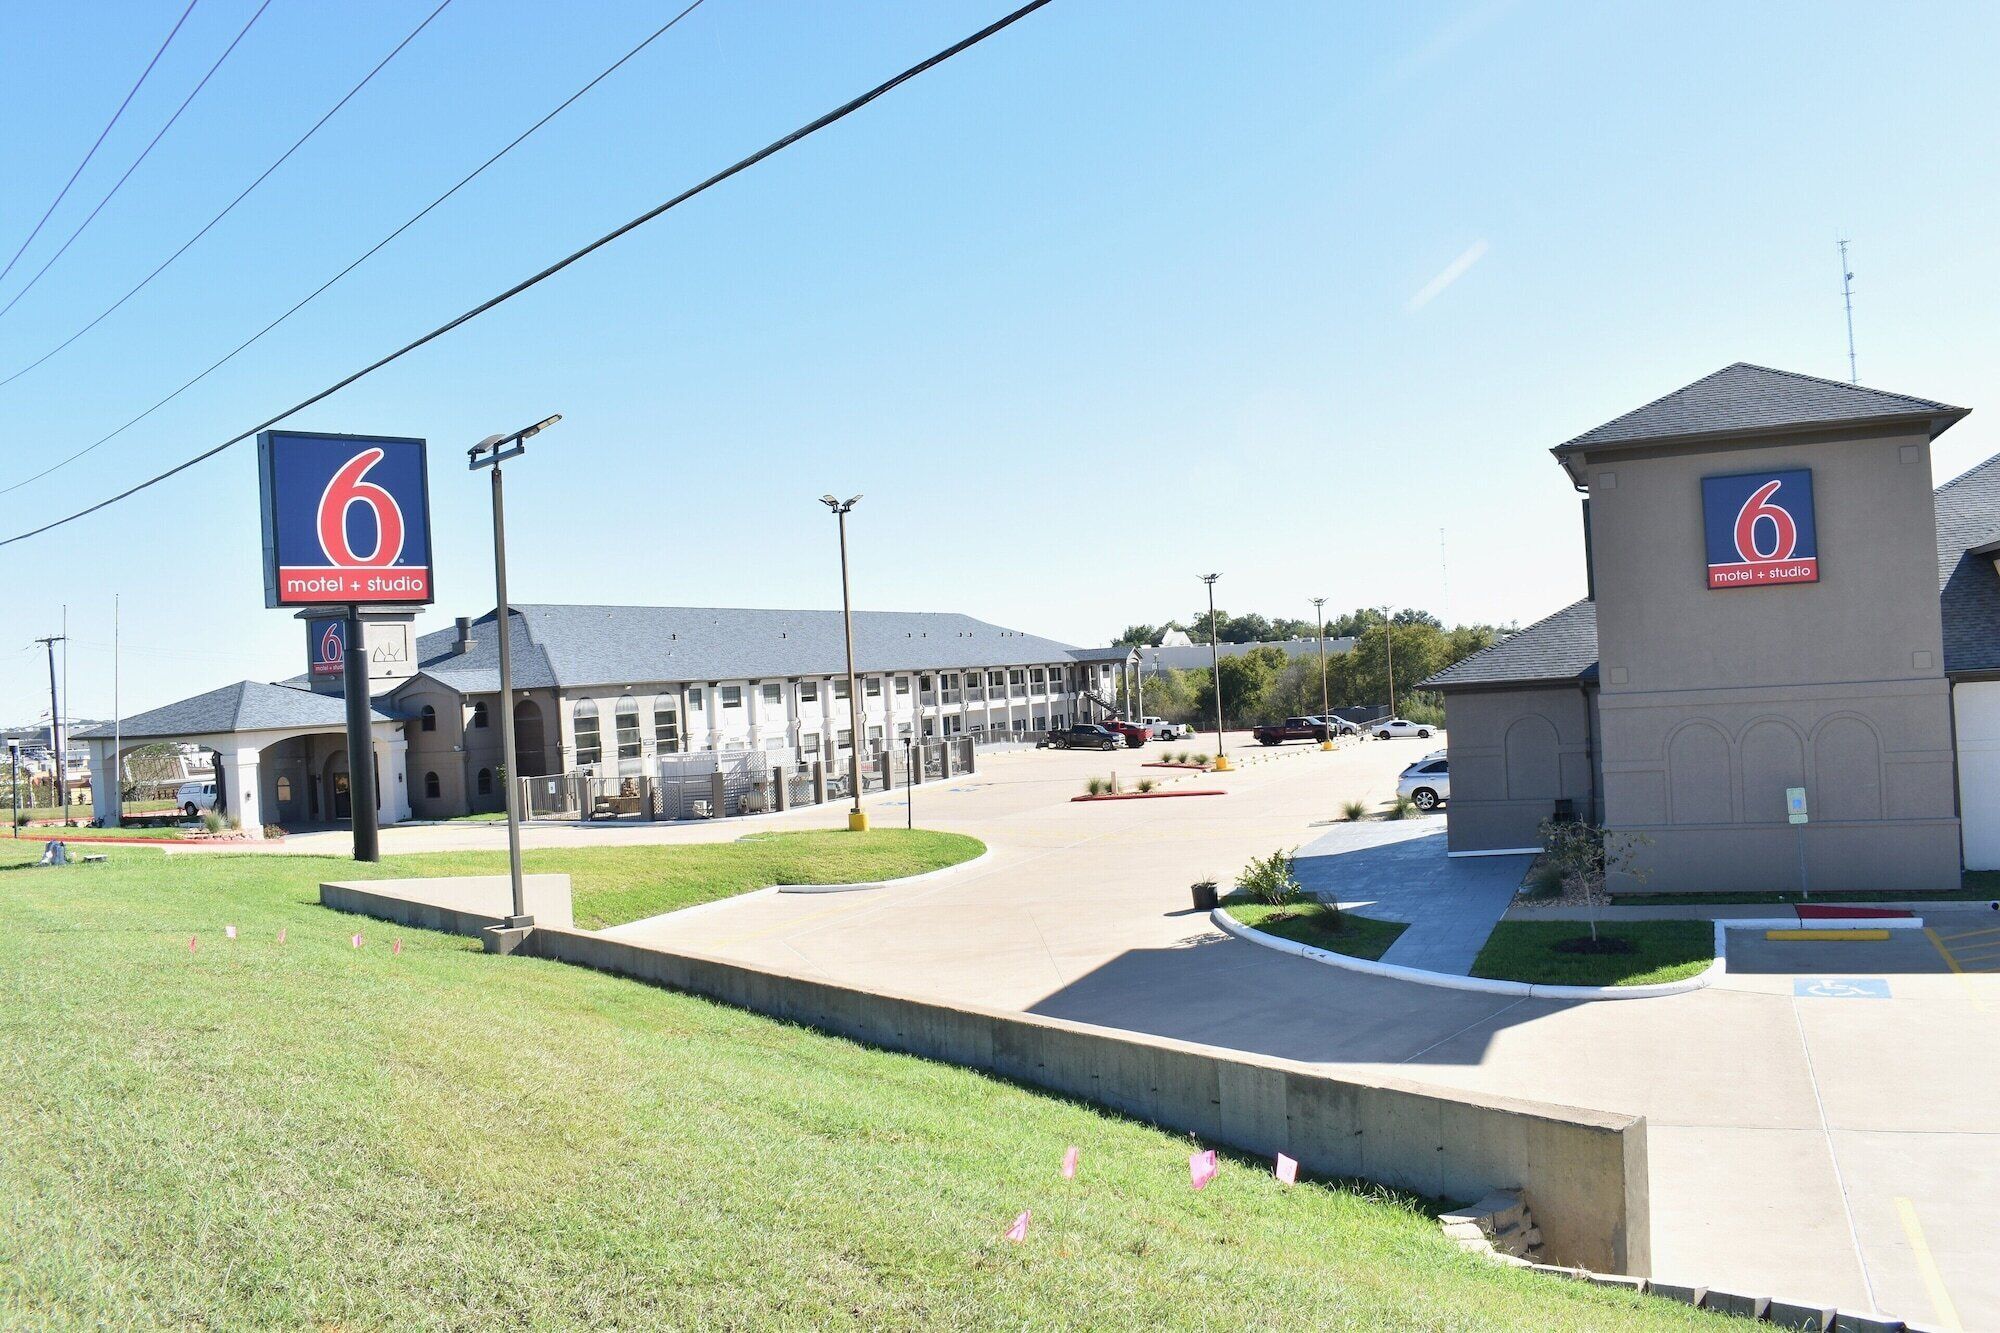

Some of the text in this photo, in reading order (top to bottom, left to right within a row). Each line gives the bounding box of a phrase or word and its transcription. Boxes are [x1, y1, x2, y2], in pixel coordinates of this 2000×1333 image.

[317, 447, 405, 567] 6
[1734, 480, 1797, 563] 6
[288, 575, 423, 592] motel + studio
[1714, 569, 1753, 582] motel
[1769, 566, 1811, 579] studio
[321, 623, 343, 663] 6
